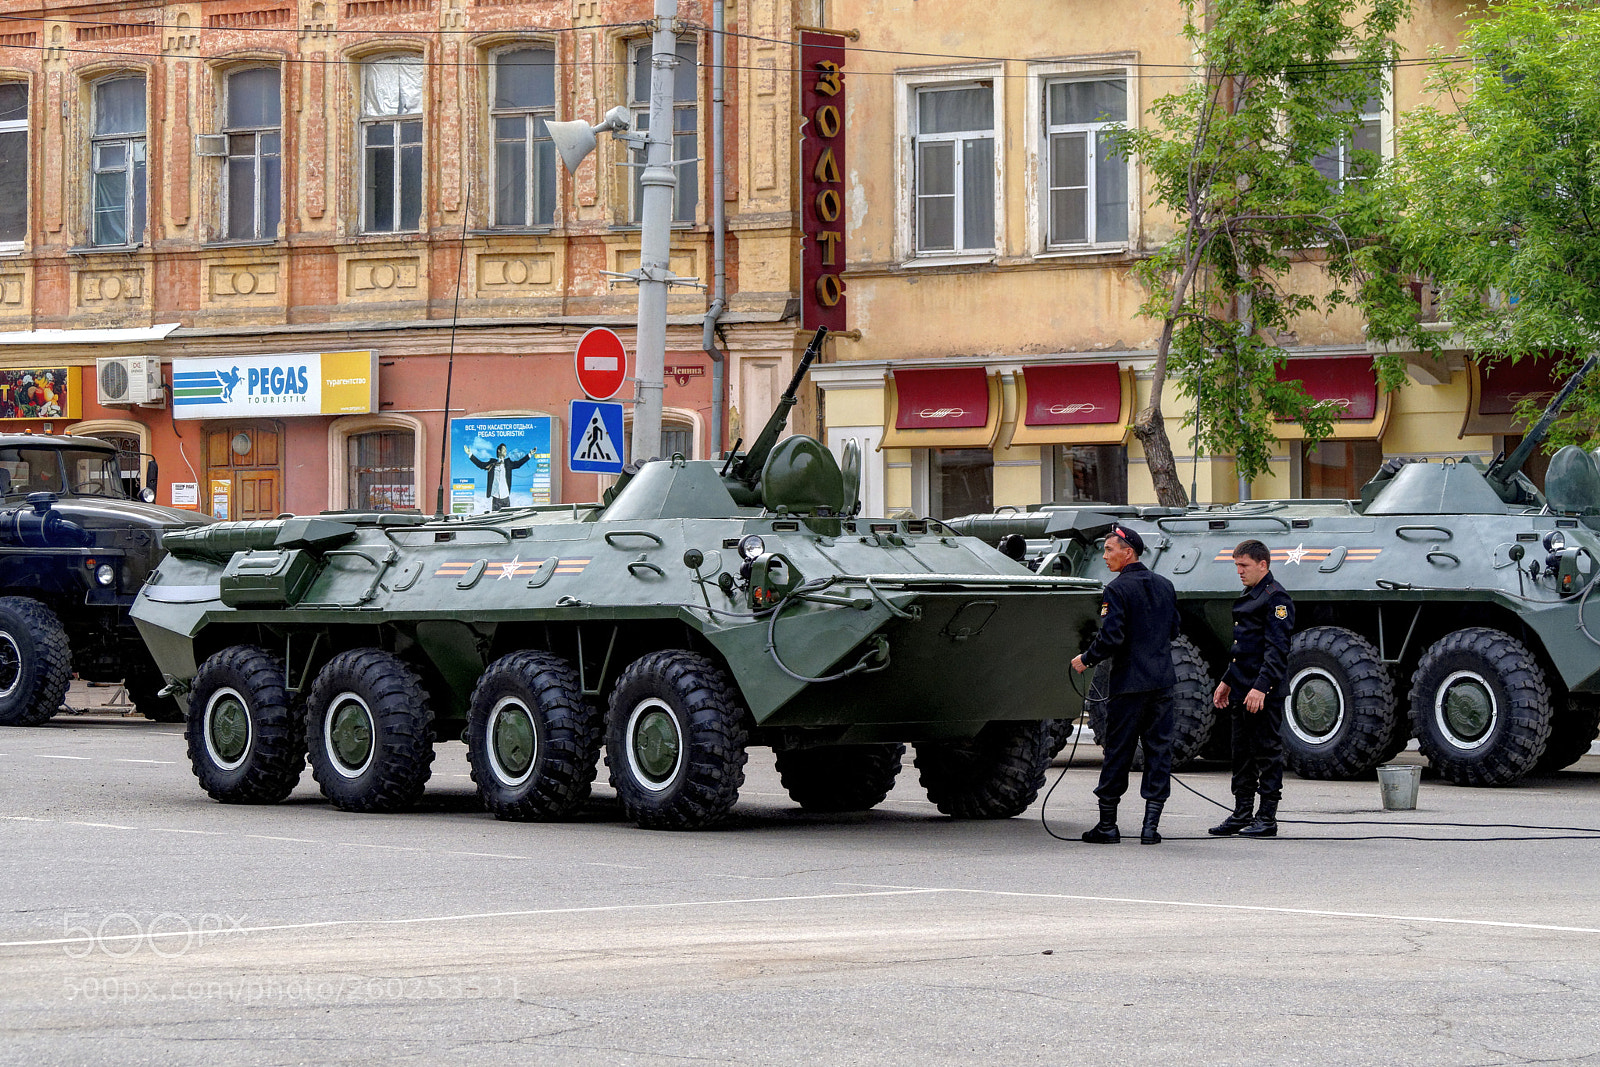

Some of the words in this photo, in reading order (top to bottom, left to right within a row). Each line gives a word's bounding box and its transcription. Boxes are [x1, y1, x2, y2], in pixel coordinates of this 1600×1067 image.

[814, 59, 842, 307] ЗОЛОТО
[670, 366, 702, 375] Ленина
[248, 366, 308, 395] PEGAS
[679, 377, 685, 385] 6
[248, 395, 306, 404] TOURISTIK
